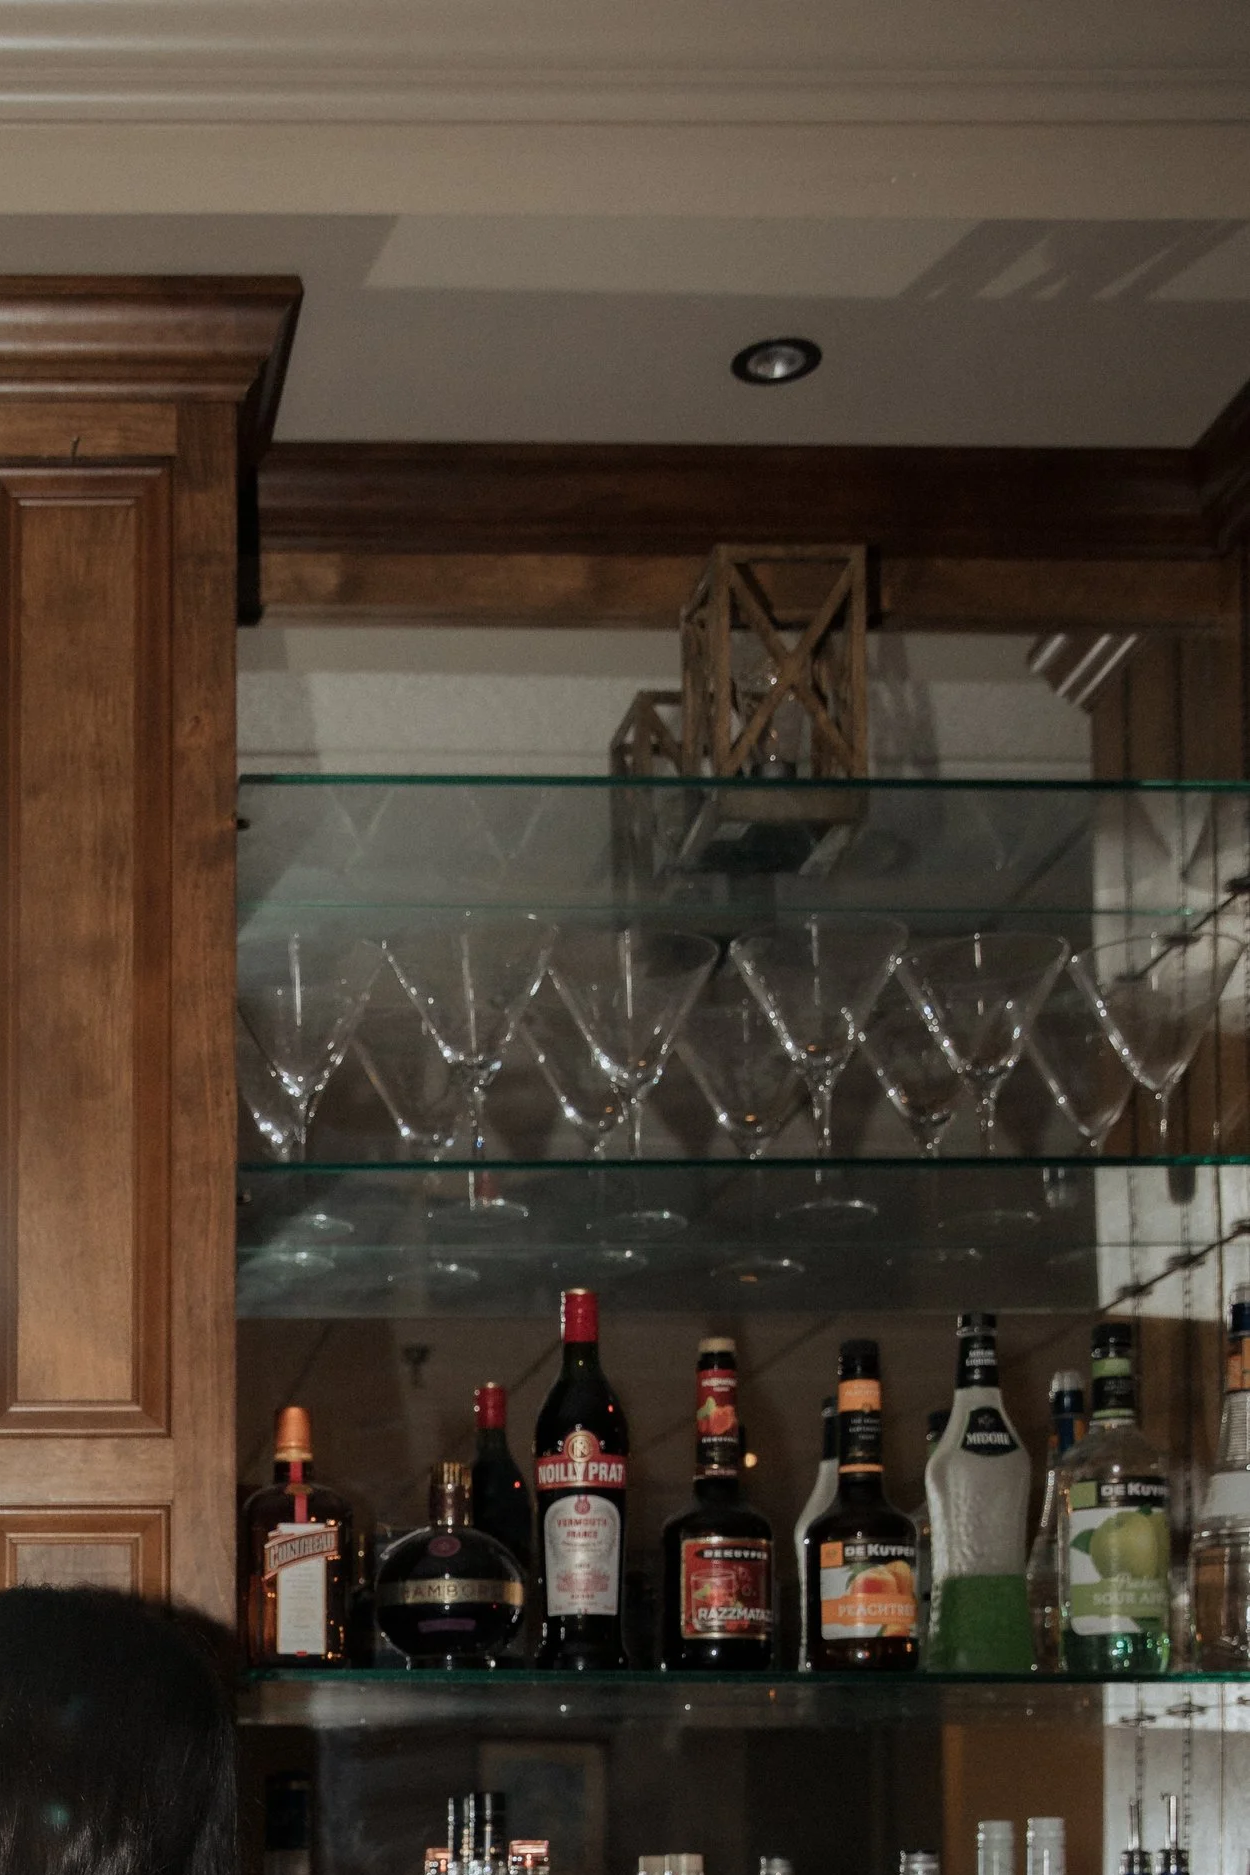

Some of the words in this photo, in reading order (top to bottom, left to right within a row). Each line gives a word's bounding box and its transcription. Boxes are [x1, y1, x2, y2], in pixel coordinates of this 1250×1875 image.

[967, 1432, 1011, 1446] MIDORI
[537, 1461, 588, 1487] NOILLY
[588, 1461, 624, 1484] PRAT
[1100, 1484, 1126, 1496] DE
[844, 1545, 867, 1558] DE
[401, 1583, 500, 1599] HAMBOR
